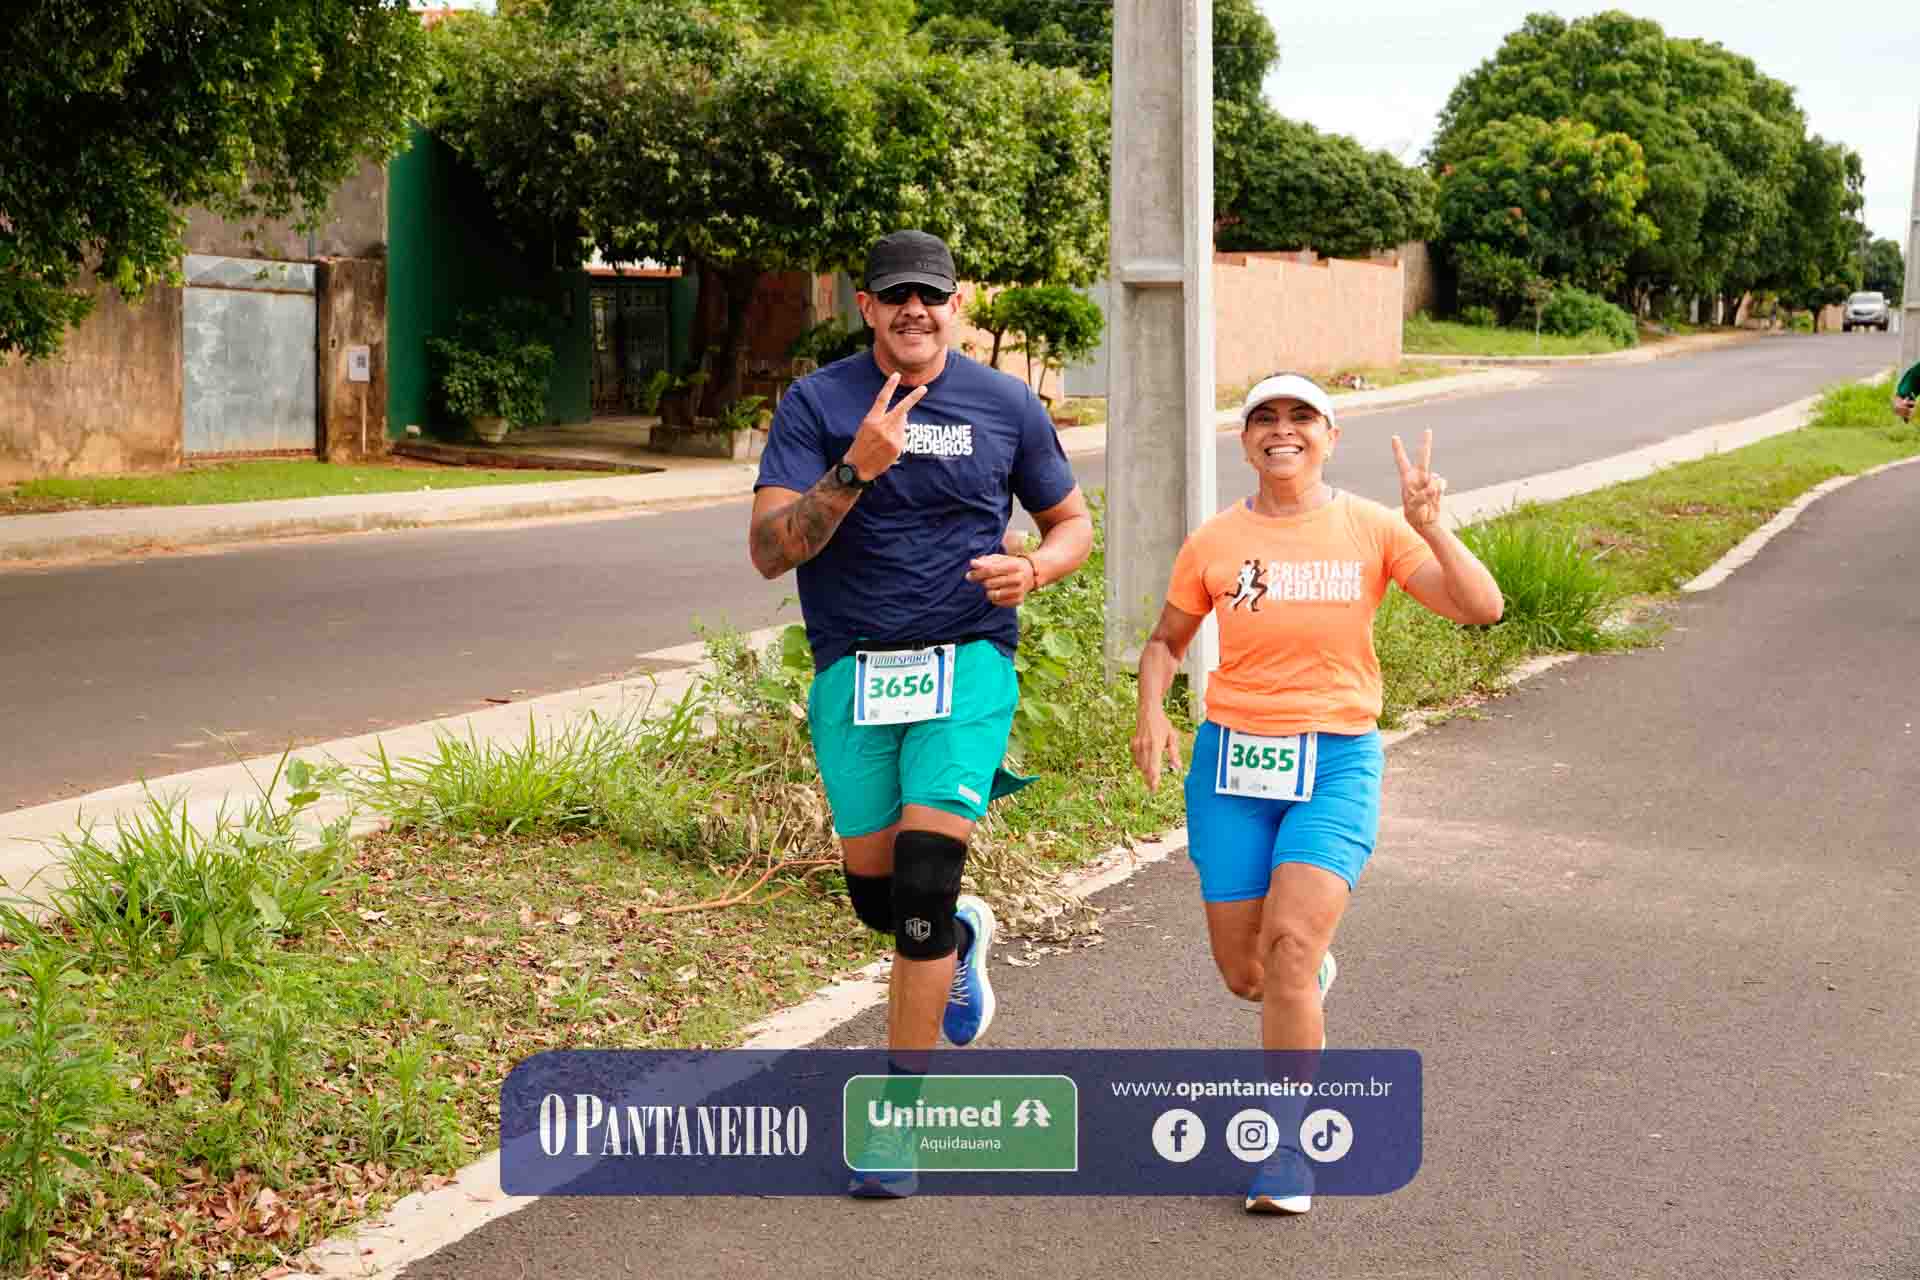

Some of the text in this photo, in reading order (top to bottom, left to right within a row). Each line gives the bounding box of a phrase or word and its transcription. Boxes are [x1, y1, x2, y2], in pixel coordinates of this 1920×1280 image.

[903, 439, 973, 456] MEDEIROS
[1268, 559, 1363, 579] CRISTIANE
[1268, 578, 1362, 601] MEDEIROS
[867, 672, 935, 699] 3656
[1230, 743, 1296, 772] 3655
